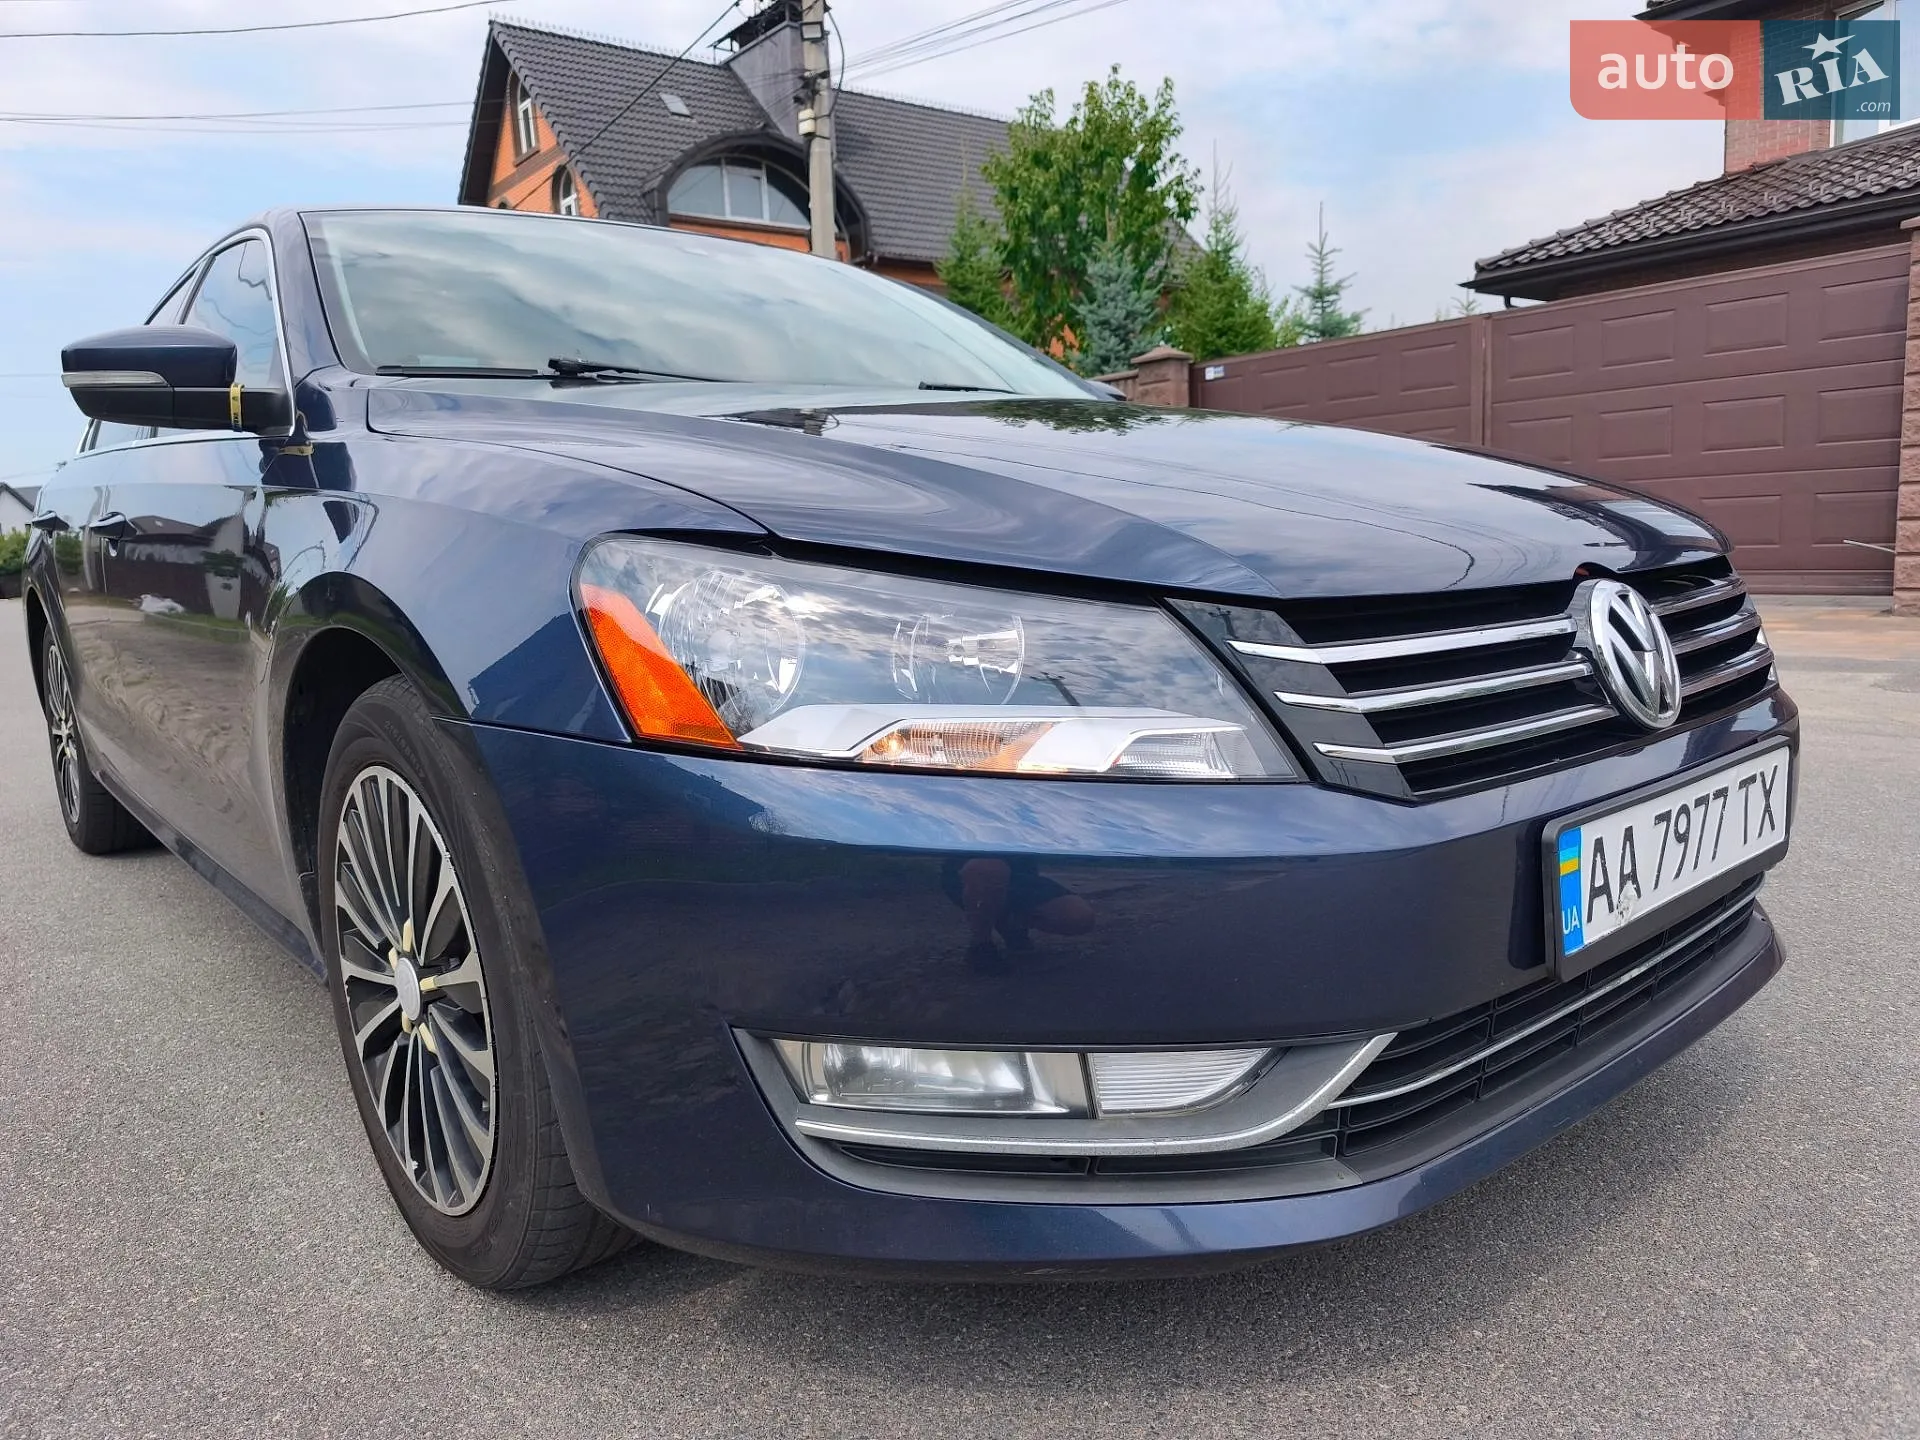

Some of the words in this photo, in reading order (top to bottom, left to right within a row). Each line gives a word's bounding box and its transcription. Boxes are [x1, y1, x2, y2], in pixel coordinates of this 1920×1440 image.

[1586, 825, 1641, 924] AA
[1653, 786, 1729, 891] 7977
[1738, 765, 1778, 845] TX
[1562, 907, 1581, 935] UA
